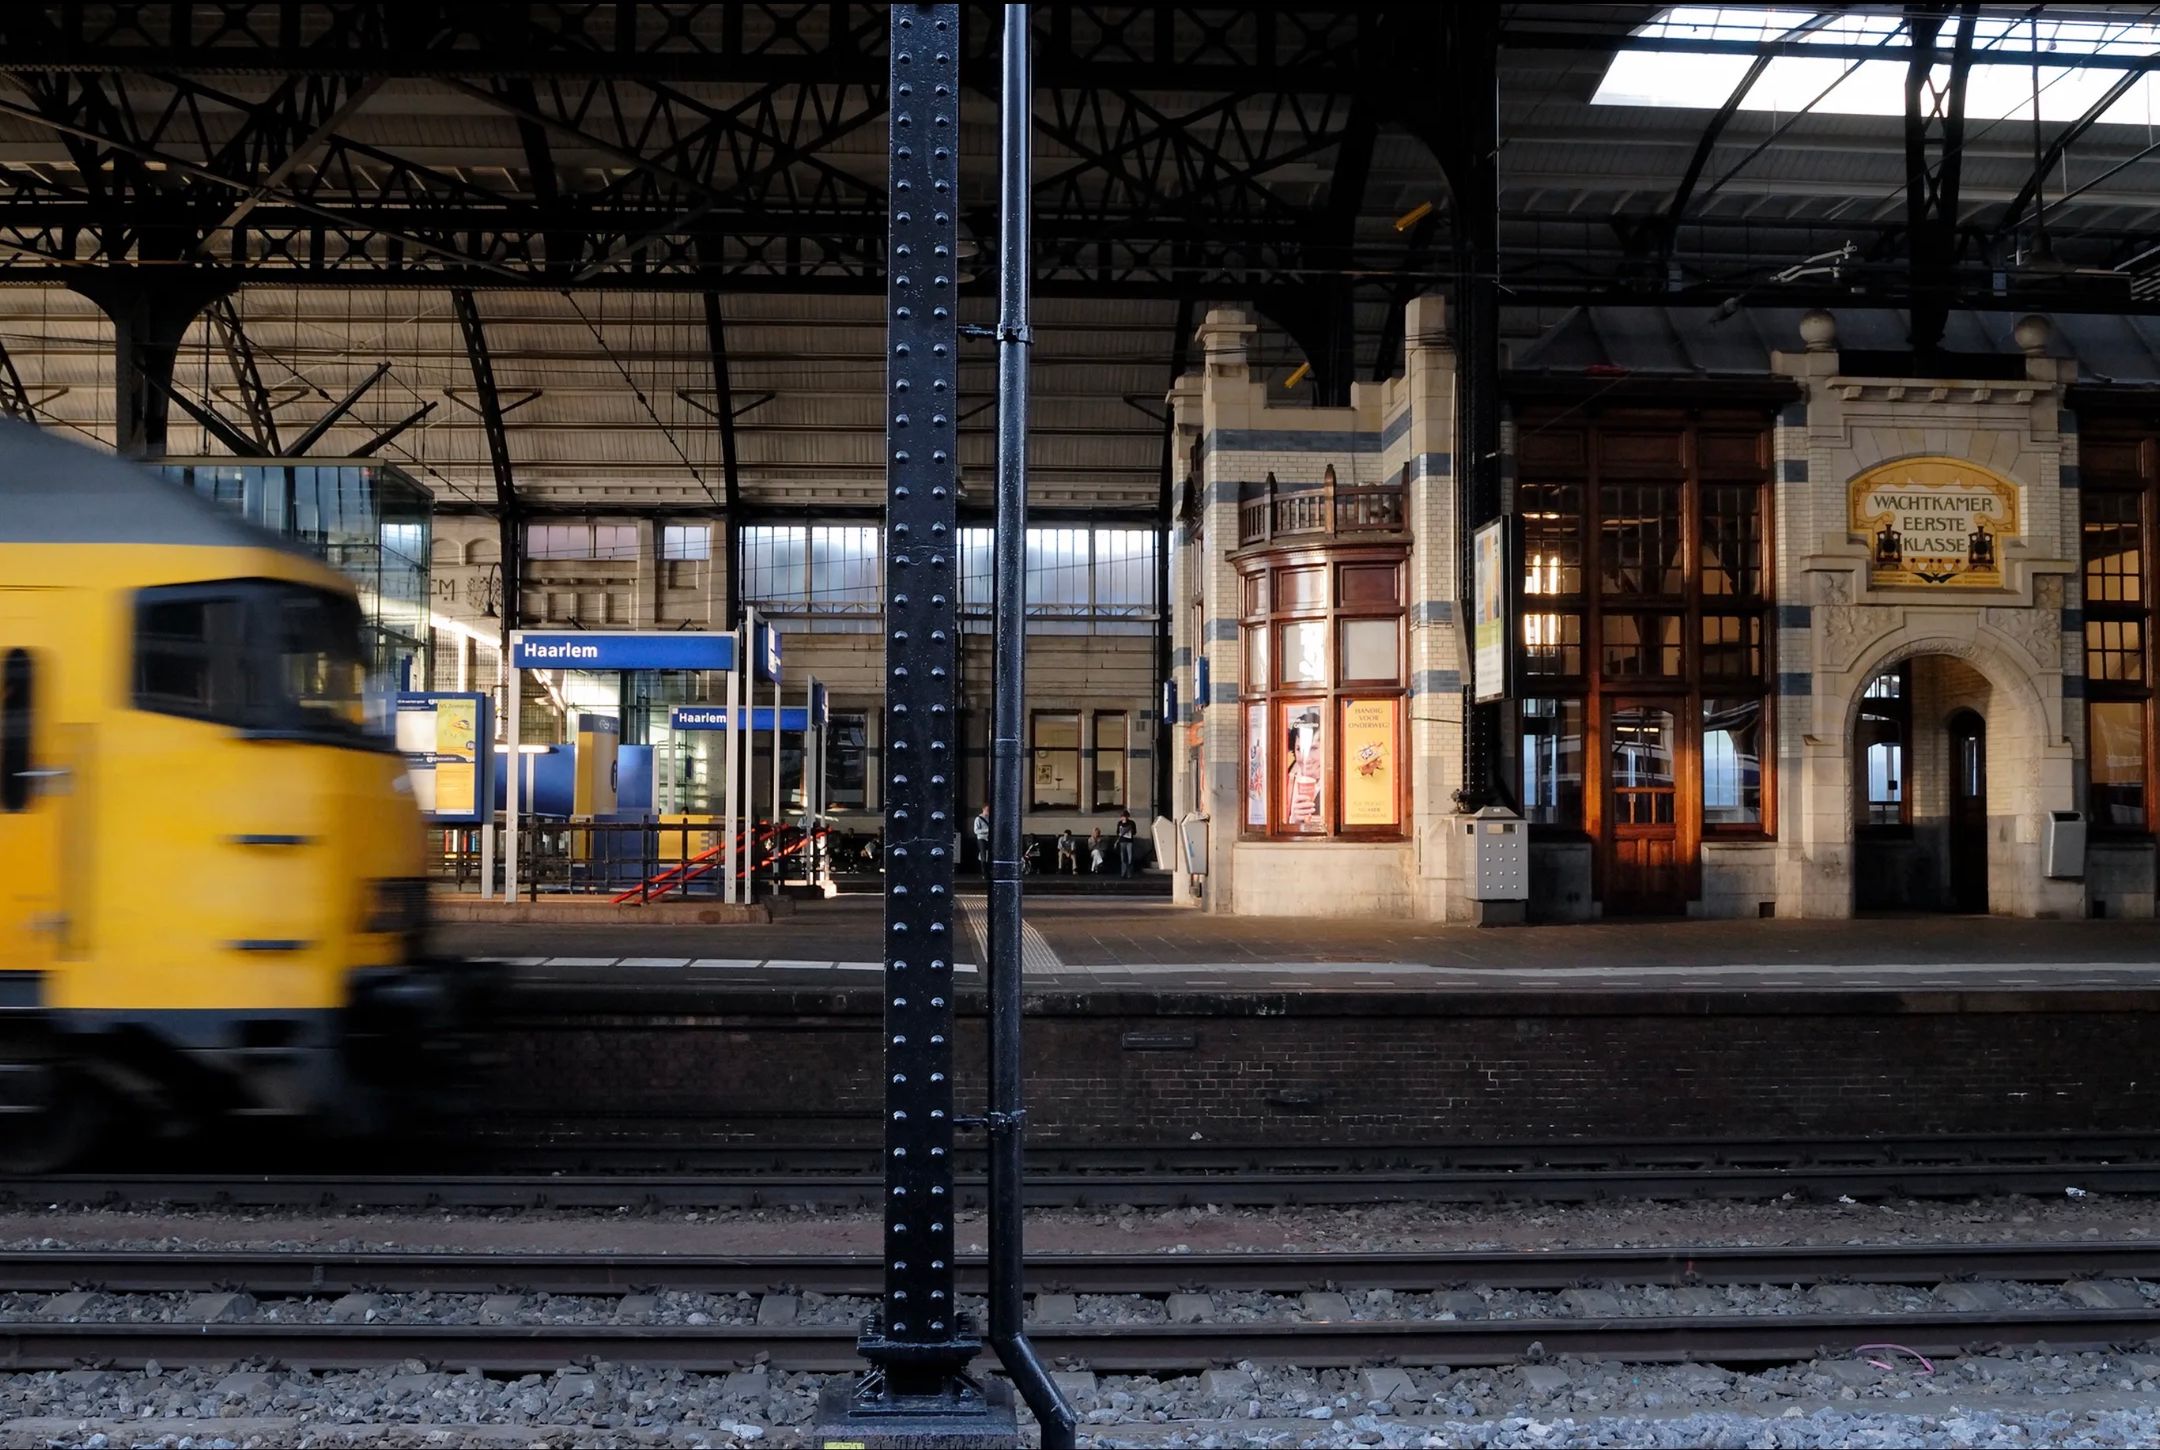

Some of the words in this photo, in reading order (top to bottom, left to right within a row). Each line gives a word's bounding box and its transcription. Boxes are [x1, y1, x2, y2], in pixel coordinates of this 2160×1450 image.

[1874, 496, 1993, 512] WACHTKAMER
[1903, 517, 1966, 532] EERSTE
[1904, 538, 1967, 553] KLASSE
[524, 642, 598, 658] Haarlem
[679, 712, 727, 723] Haarlem
